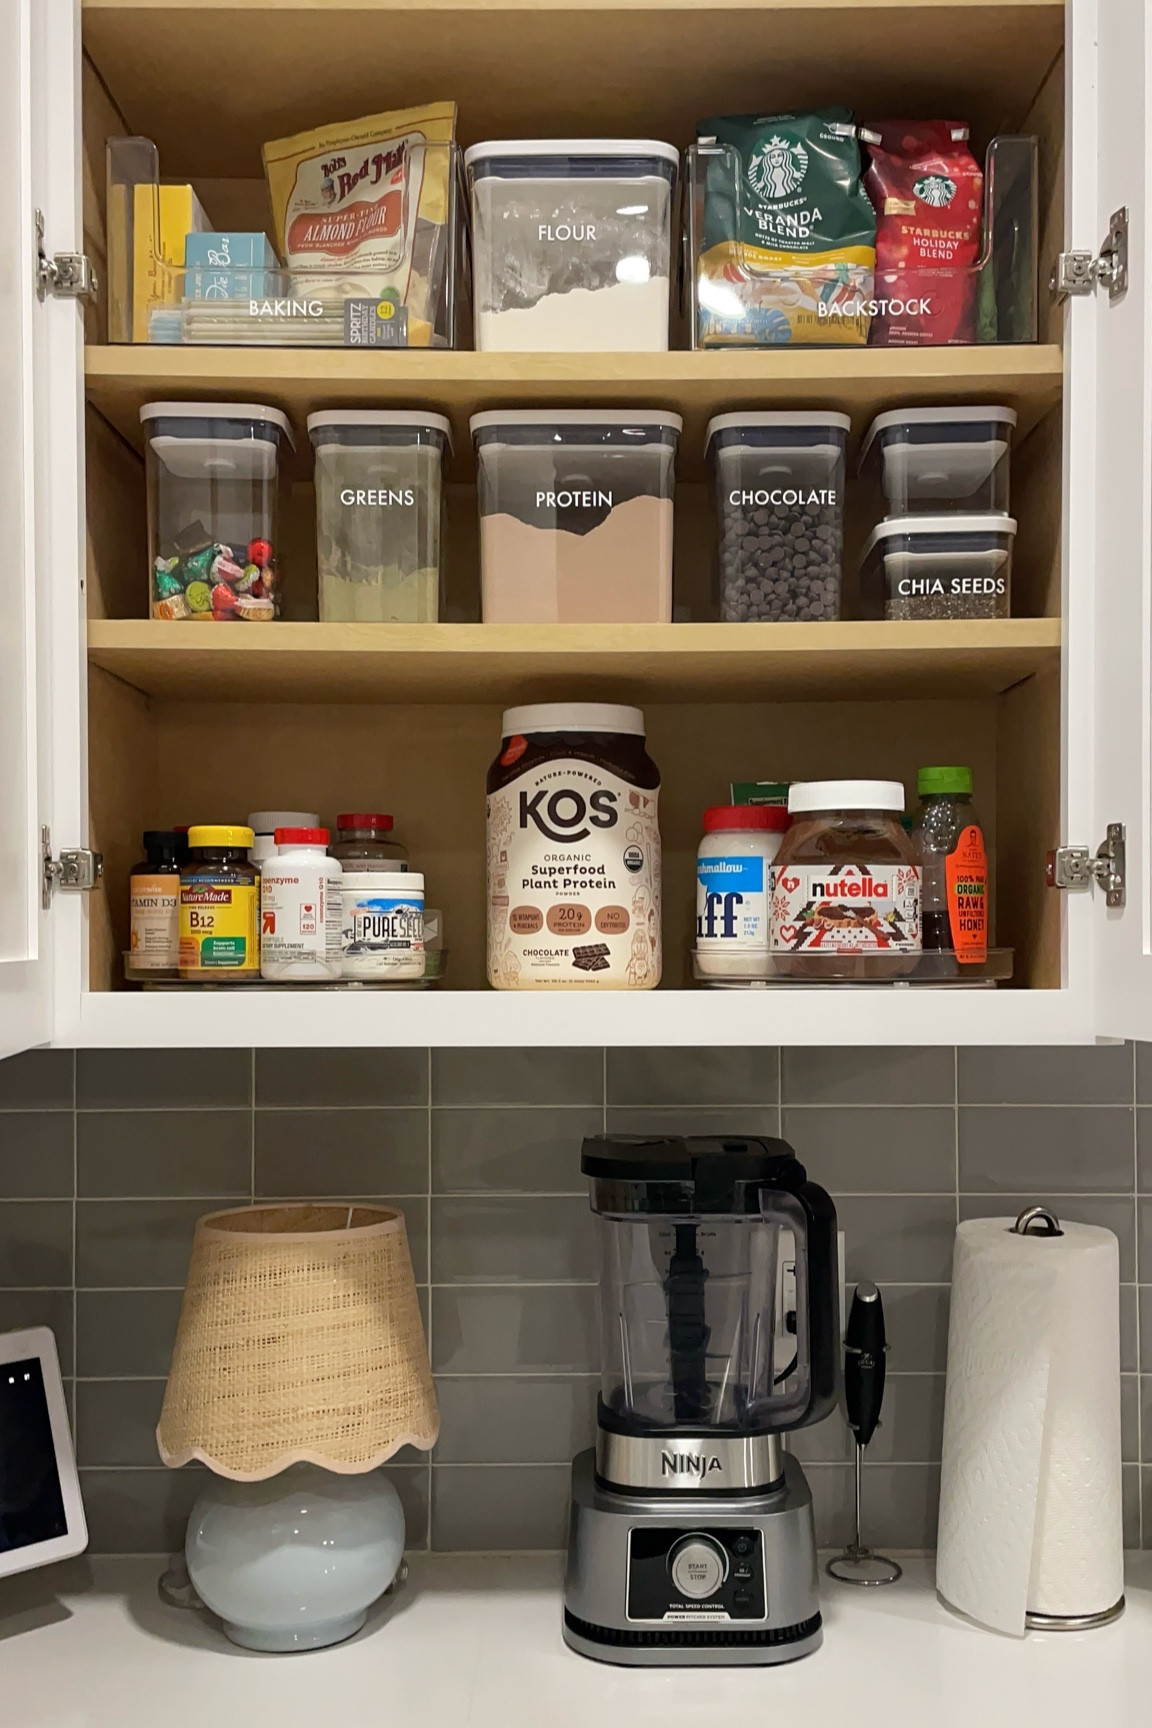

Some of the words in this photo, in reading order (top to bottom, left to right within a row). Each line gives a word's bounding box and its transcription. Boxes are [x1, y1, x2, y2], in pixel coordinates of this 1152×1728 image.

[320, 155, 347, 178] Bob's
[337, 157, 370, 204] Red
[758, 197, 804, 211] STARBUCKS
[303, 221, 356, 242] ALMOND
[355, 205, 387, 237] FLOUR
[743, 207, 823, 226] VERANDA
[538, 225, 597, 241] FLOUR
[758, 219, 810, 239] BLEND
[901, 225, 970, 241] STARBUCKS
[913, 237, 959, 250] HOLIDAY
[919, 247, 954, 260] BLEND
[249, 300, 324, 317] BAKING
[817, 298, 932, 317] BACKSTOCK
[350, 302, 361, 344] SPRITZ
[340, 489, 415, 507] GREENS
[536, 491, 613, 508] PROTEIN
[729, 489, 837, 506] CHOCOLATE
[898, 578, 945, 596] CHIA
[950, 577, 1006, 595] SEEDS
[535, 769, 602, 787] NATURE-POWERED
[519, 789, 619, 844] KOS
[544, 854, 592, 862] ORGANIC
[531, 864, 606, 878] Superfood
[957, 875, 974, 883] 100%
[522, 878, 559, 890] Plant
[563, 878, 617, 890] Protein
[812, 877, 888, 898] nutella
[162, 898, 177, 908] D3
[957, 896, 980, 910] RAW
[189, 911, 215, 928] B12
[607, 912, 620, 920] NO
[959, 918, 984, 931] HONEY
[363, 915, 398, 938] PURE
[522, 949, 570, 957] CHOCOLATE
[661, 1450, 723, 1479] NINJA
